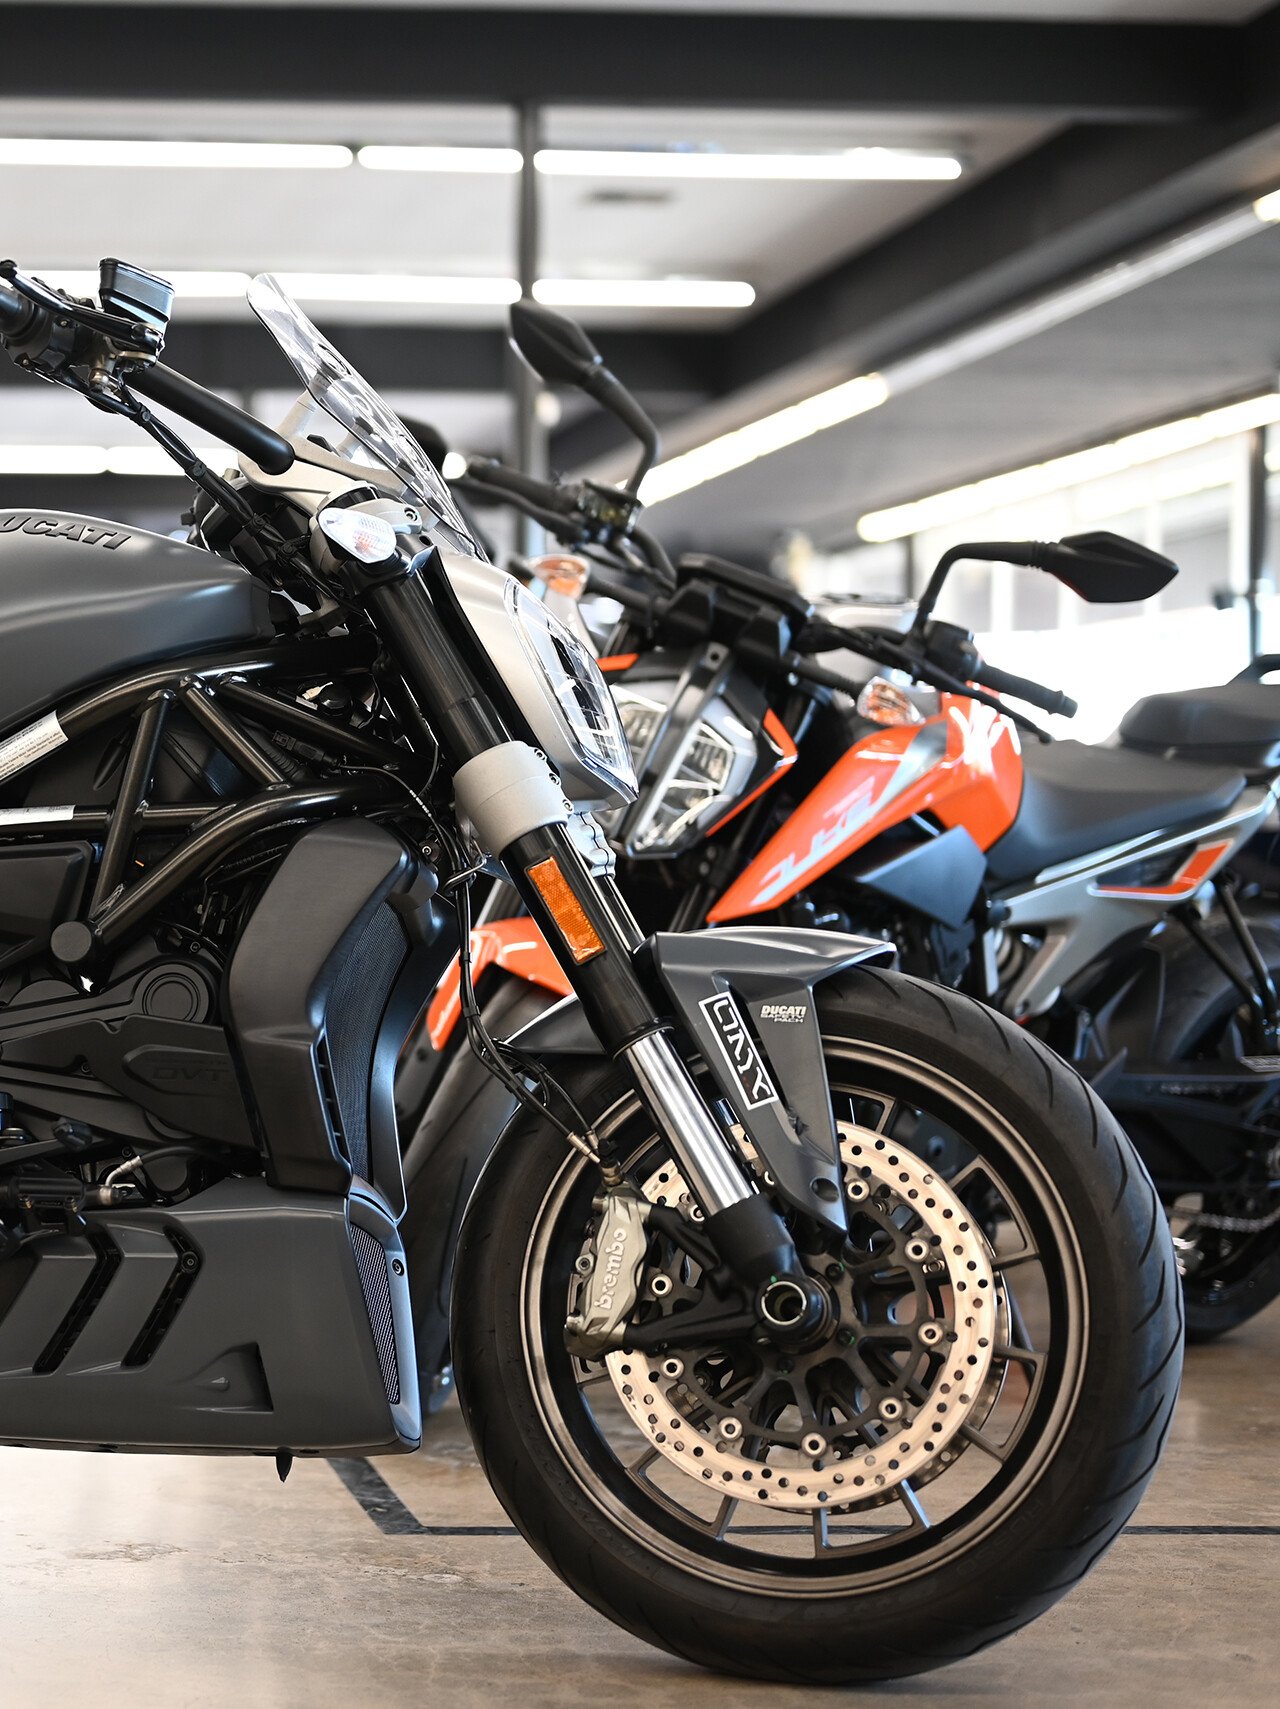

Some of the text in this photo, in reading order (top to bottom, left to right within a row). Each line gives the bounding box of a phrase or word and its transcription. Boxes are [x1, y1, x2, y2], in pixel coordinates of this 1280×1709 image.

[712, 998, 772, 1100] ONYX
[761, 1005, 807, 1015] DUCATI
[593, 1226, 629, 1311] brembo
